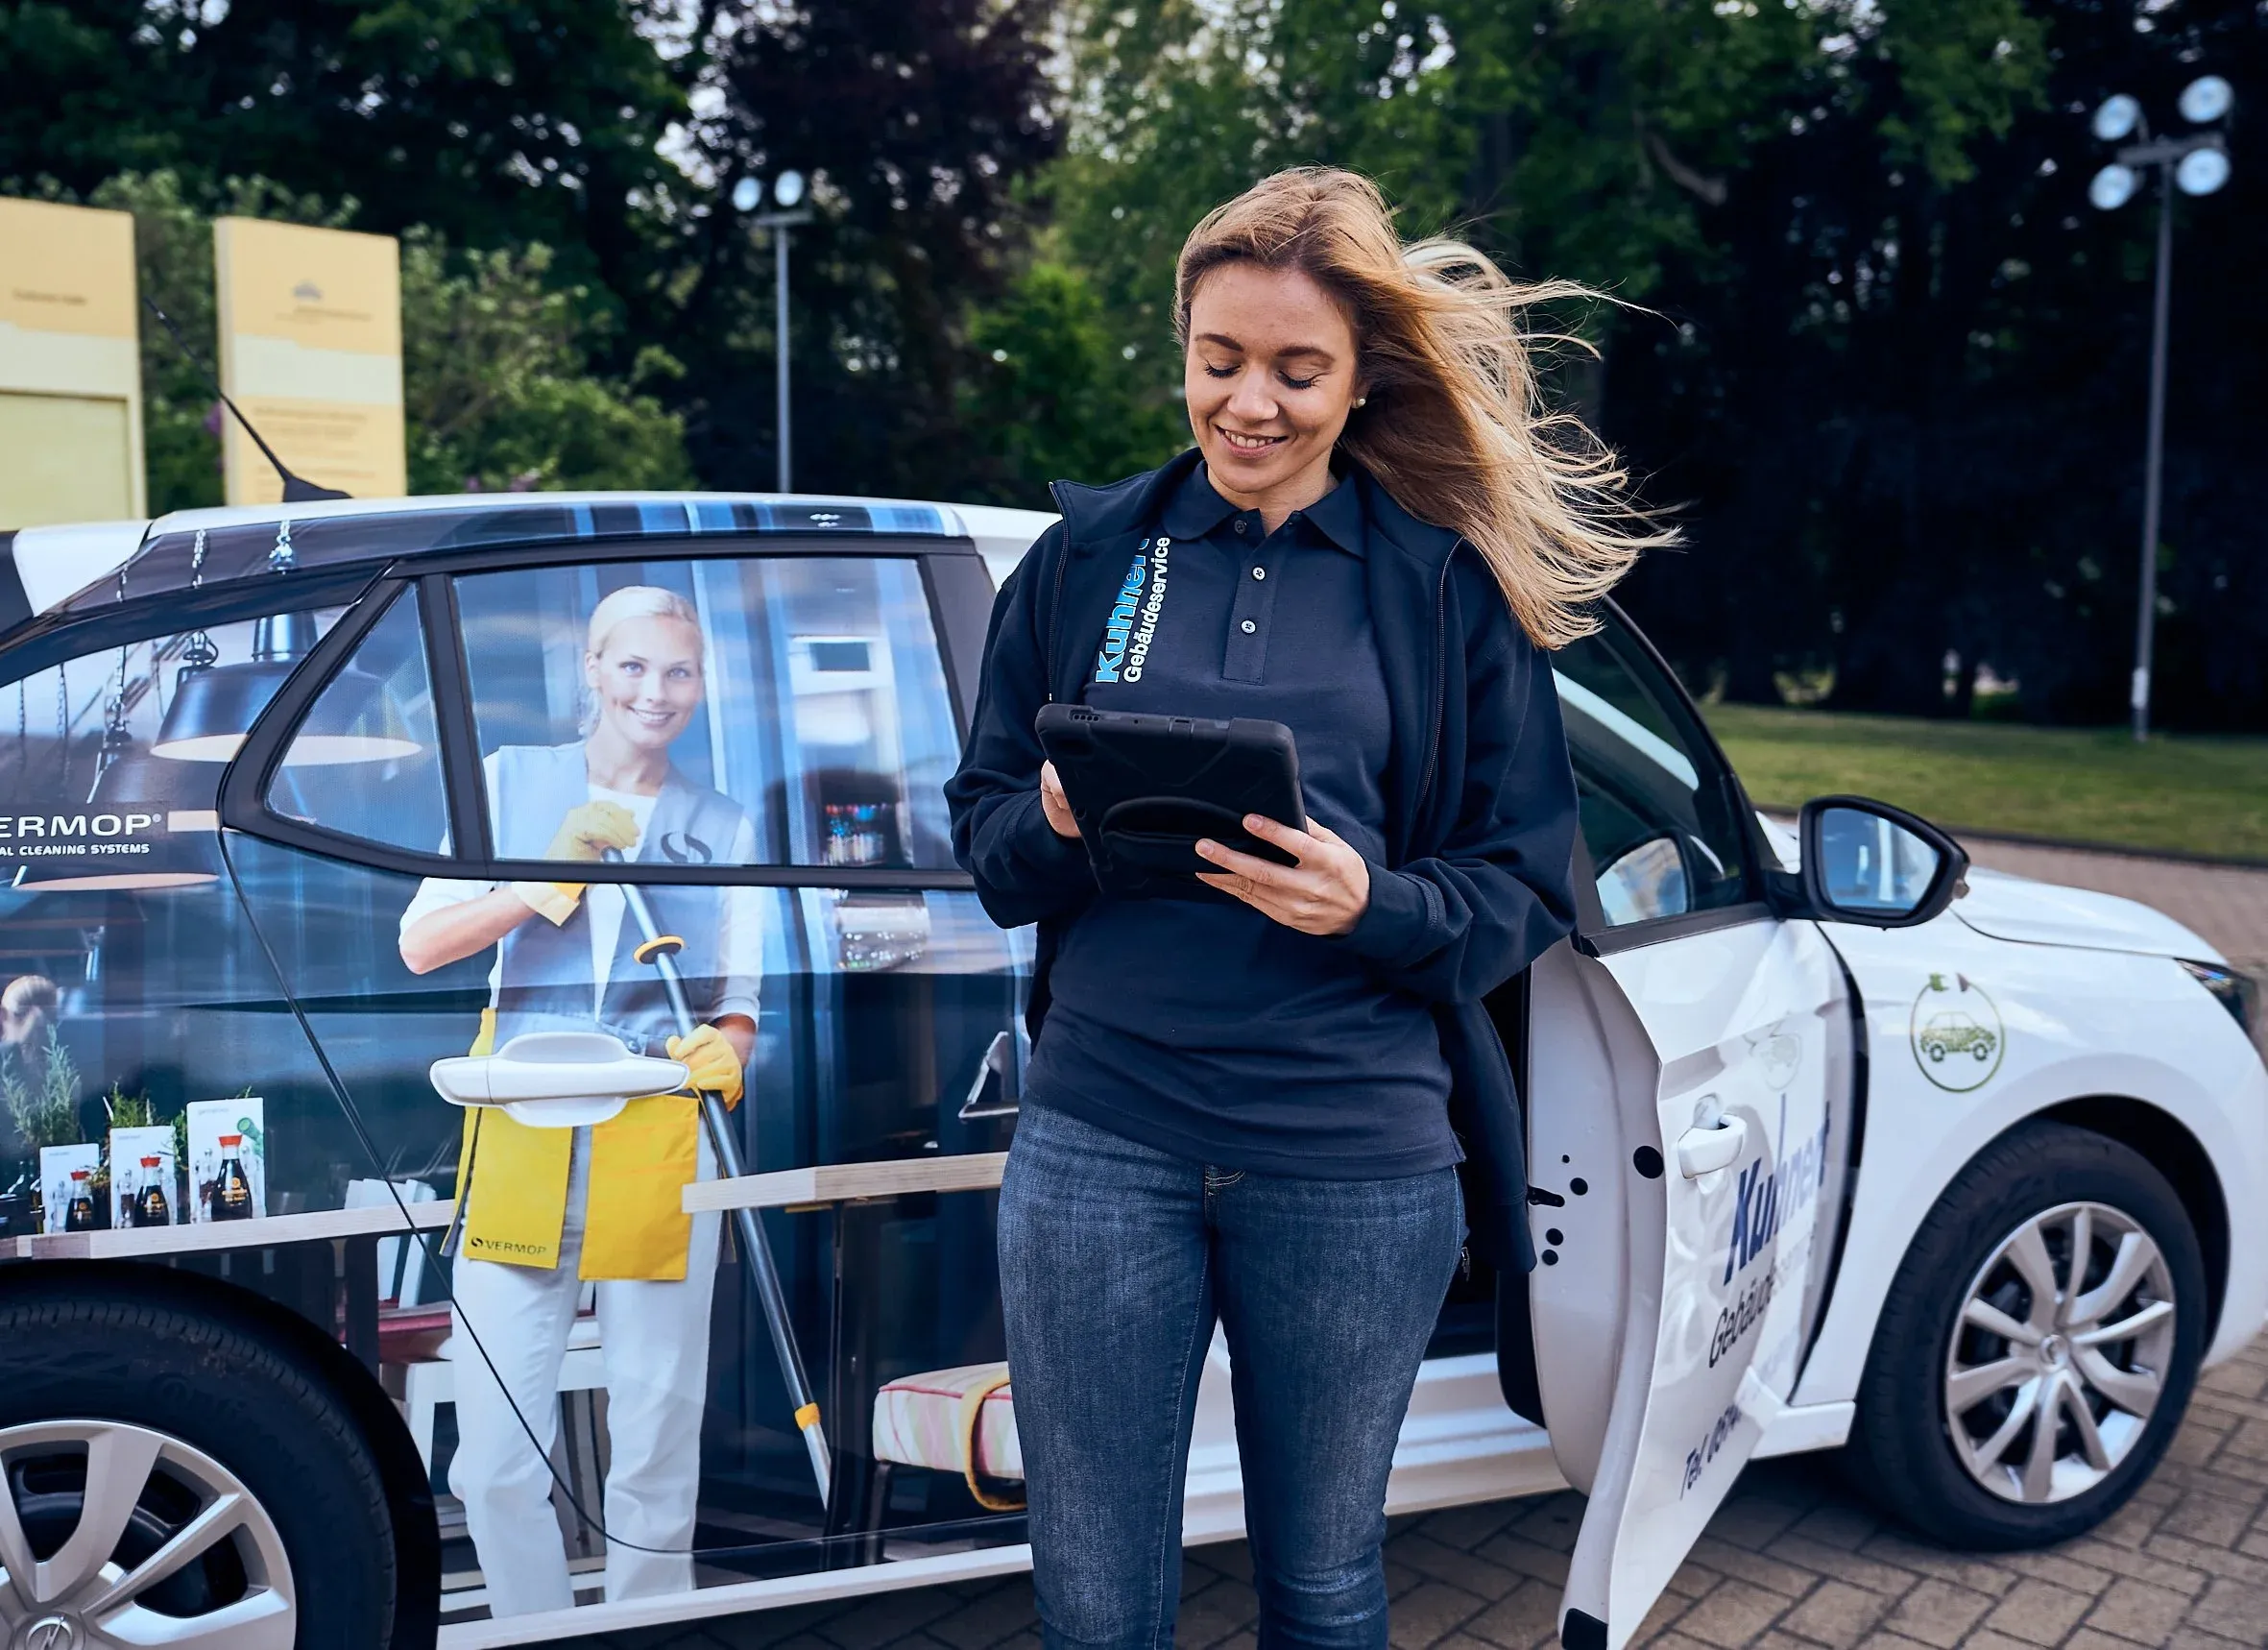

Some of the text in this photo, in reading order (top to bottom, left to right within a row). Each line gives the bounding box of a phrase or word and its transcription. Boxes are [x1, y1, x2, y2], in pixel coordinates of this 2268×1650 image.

[1123, 537, 1171, 683] Gebäudeservice
[19, 844, 86, 857] CLEANING
[90, 843, 151, 855] SYSTEMS
[485, 1240, 547, 1255] VERMOP
